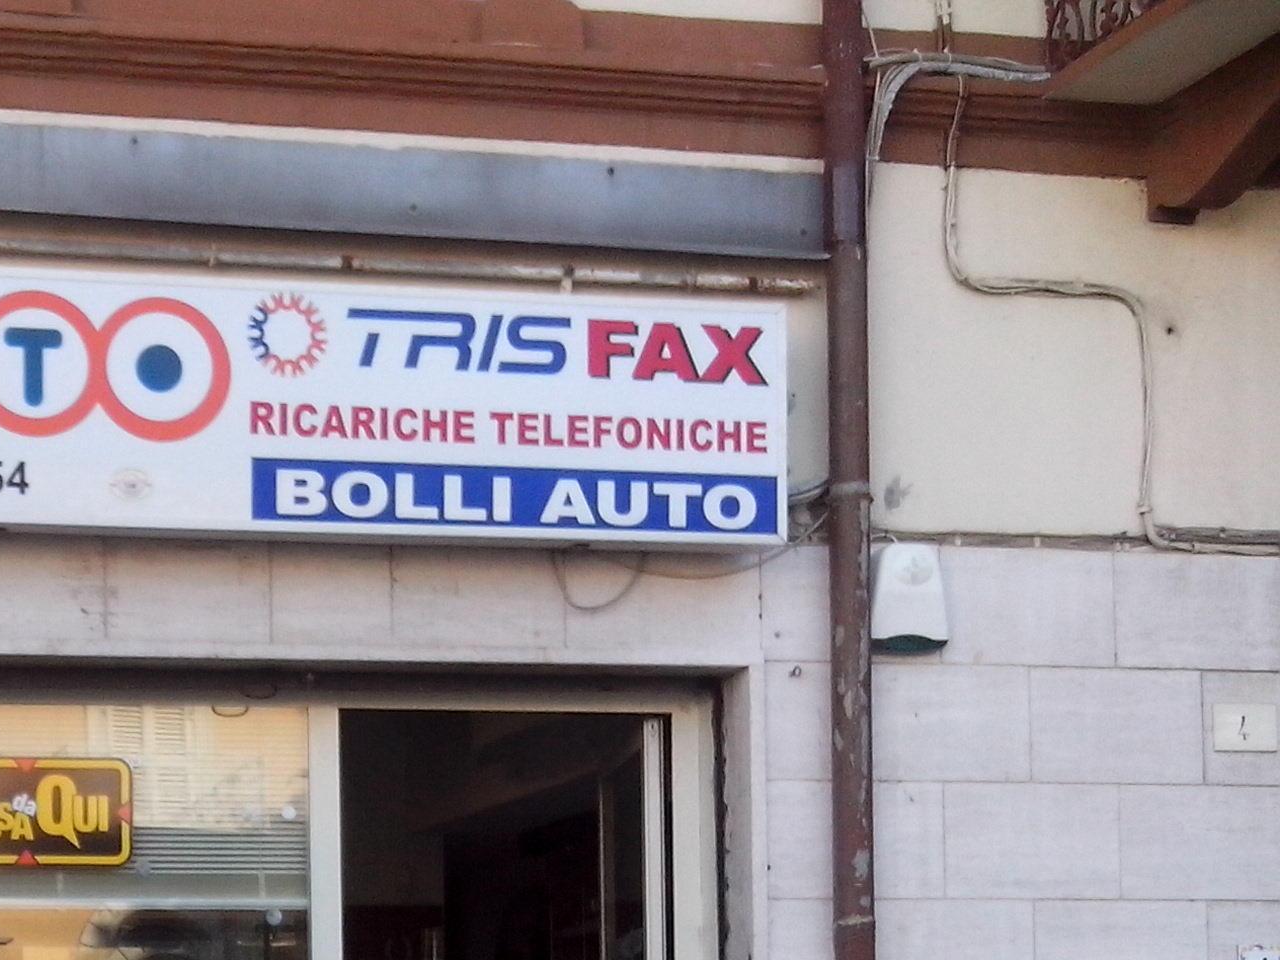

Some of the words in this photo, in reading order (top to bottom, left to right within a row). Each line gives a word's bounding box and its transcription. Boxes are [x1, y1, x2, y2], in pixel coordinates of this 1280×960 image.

[347, 309, 571, 374] TRIS
[586, 319, 768, 385] FAX
[250, 401, 475, 443] RICARICHE
[490, 411, 768, 453] TELEFONICHE
[275, 468, 511, 523] BOLLI
[540, 477, 757, 529] AUTO
[12, 793, 37, 817] da
[36, 774, 109, 849] QUI
